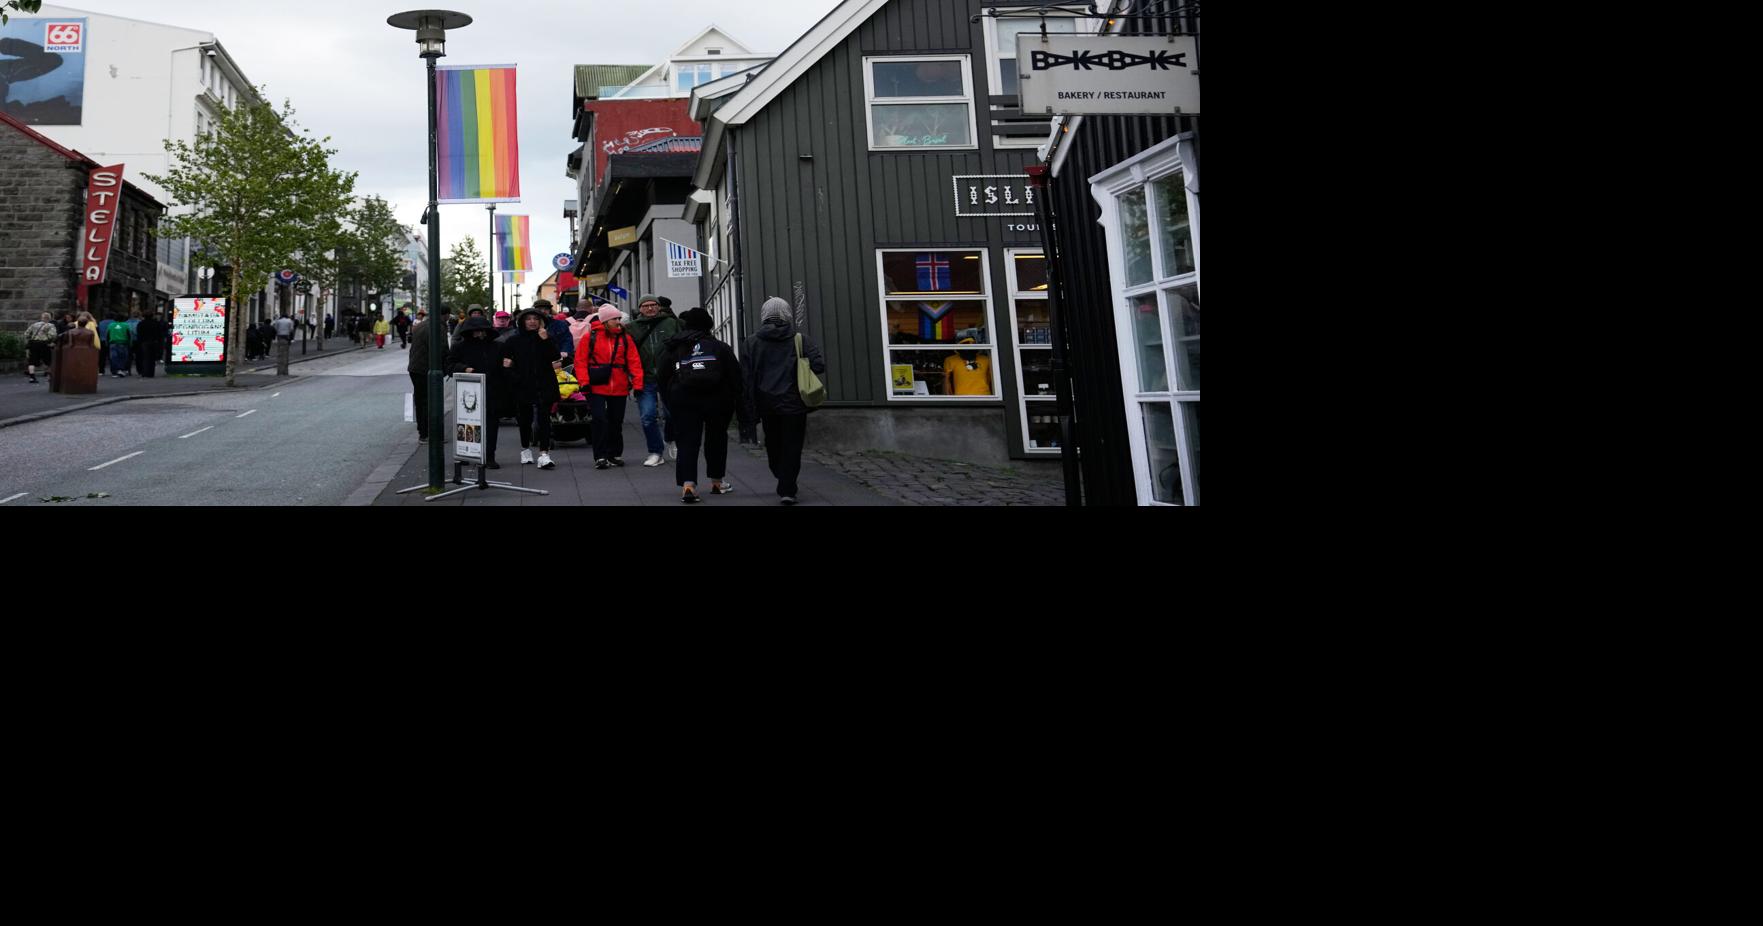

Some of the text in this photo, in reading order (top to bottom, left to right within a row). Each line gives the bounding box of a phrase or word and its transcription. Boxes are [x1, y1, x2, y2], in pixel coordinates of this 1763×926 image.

[1058, 91, 1095, 99] BAKERY
[1104, 91, 1166, 99] RESTAURANT
[86, 172, 117, 280] STELLA
